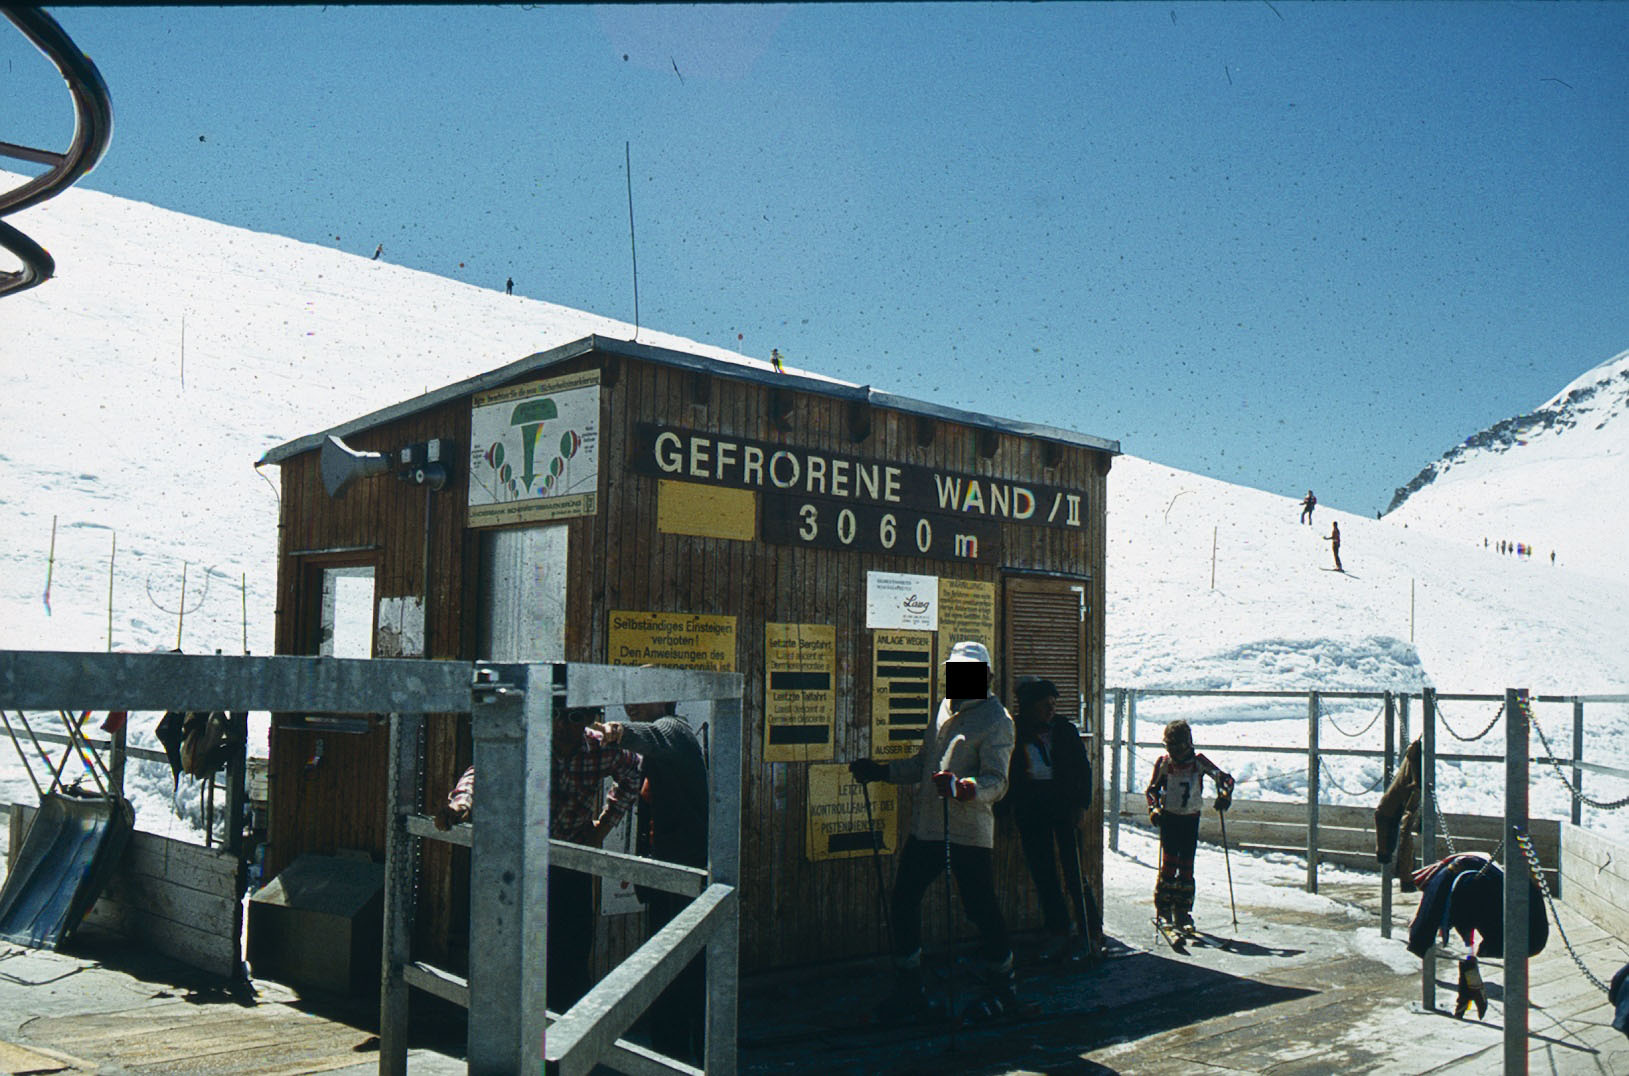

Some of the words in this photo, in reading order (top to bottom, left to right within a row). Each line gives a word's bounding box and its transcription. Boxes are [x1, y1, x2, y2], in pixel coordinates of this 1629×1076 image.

[654, 431, 901, 503] GEFRORENE
[934, 473, 1036, 520] WAND
[954, 533, 978, 558] m
[613, 617, 684, 634] Selbständiges
[686, 620, 733, 636] Einsteigen
[877, 635, 904, 646] ANLAGE
[620, 645, 642, 658] Den
[643, 646, 707, 662] Anweisungen
[710, 649, 725, 660] des
[876, 686, 888, 694] von
[875, 743, 903, 755] AUSSER
[1179, 782, 1191, 808] 7
